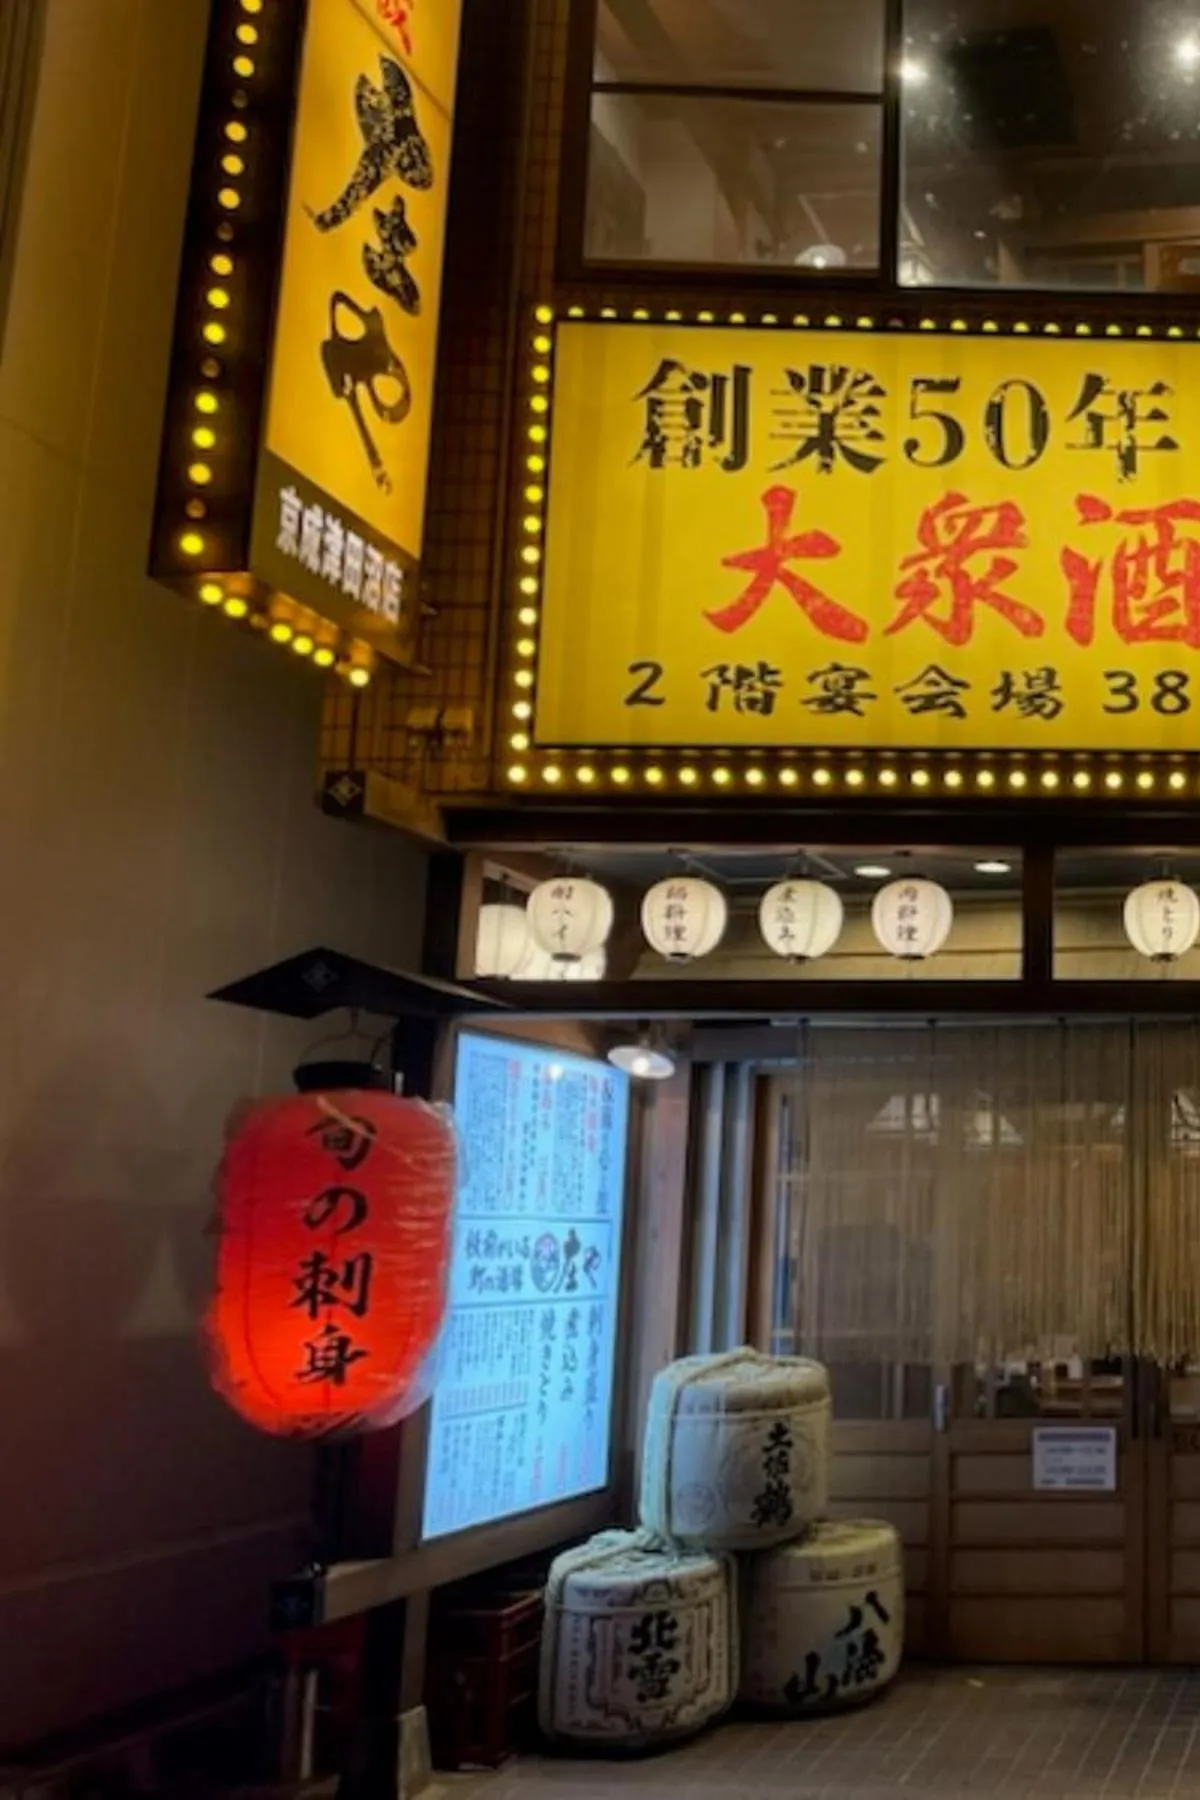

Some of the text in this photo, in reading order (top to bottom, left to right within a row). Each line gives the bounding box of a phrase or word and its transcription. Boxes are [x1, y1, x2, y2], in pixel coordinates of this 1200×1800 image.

[302, 54, 433, 496] 庄や
[629, 358, 1181, 483] 創業50年
[288, 1112, 378, 1388] 旬の刺身
[750, 1421, 793, 1529] 土佐鶴
[627, 1610, 682, 1703] 北雪
